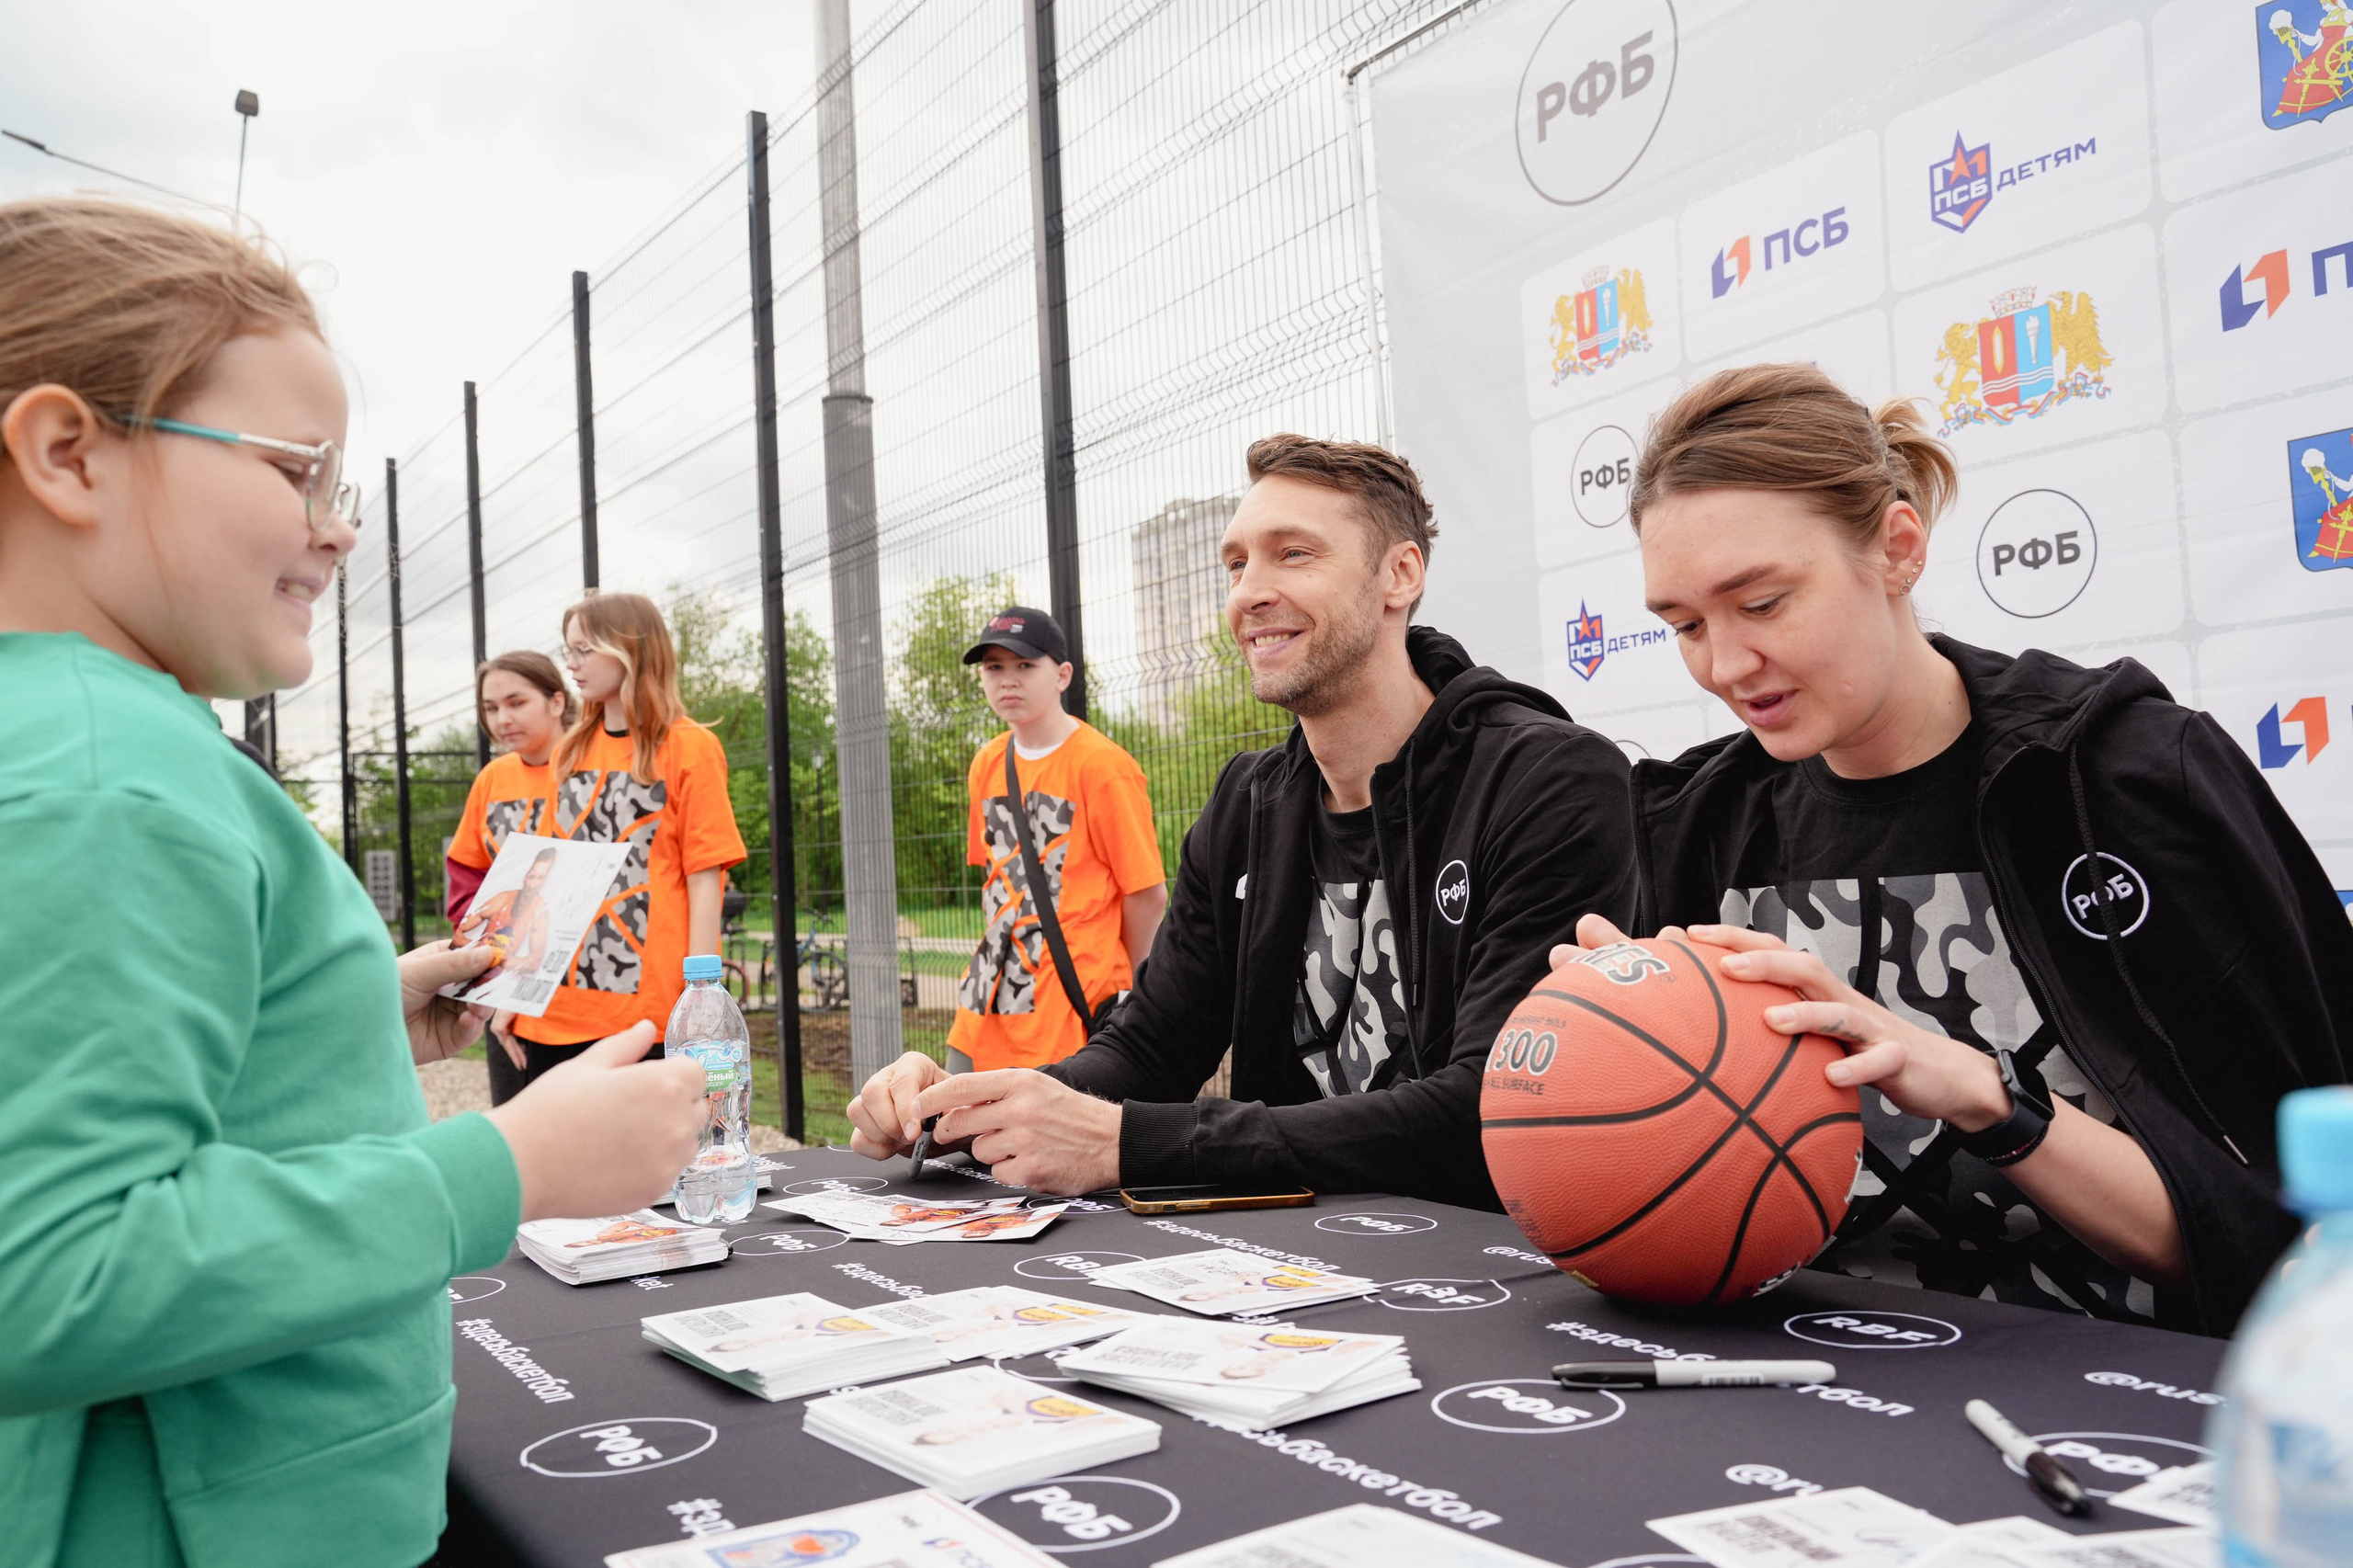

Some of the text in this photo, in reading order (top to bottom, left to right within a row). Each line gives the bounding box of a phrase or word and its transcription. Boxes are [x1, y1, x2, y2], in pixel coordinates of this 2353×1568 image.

[1536, 29, 1654, 143] РФБ
[1935, 137, 2097, 212] ПСБ ДЕТЯМ
[1763, 206, 1849, 271] ПСБ
[2312, 241, 2353, 297] П
[1580, 457, 1631, 495] РФБ
[1992, 530, 2081, 576] РФБ
[1569, 629, 1666, 661] ПСБ ДЕТЯМ
[1440, 878, 1467, 907] РФБ
[1485, 1028, 1559, 1077] 300
[706, 1070, 734, 1083] ёный
[1052, 1197, 1116, 1212] РФБ
[759, 1233, 818, 1251] РФБ
[1339, 1216, 1415, 1233] РФБ
[1045, 1256, 1103, 1273] RB
[1143, 1220, 1341, 1272] #здесьбаскетбол
[1392, 1283, 1486, 1304] RBF
[1812, 1316, 1938, 1342] RBF
[455, 1318, 575, 1403] #здесьбаскетбол
[1467, 1386, 1594, 1425] РФБ
[579, 1425, 664, 1468] РФБ
[1009, 1485, 1134, 1540] РФБ
